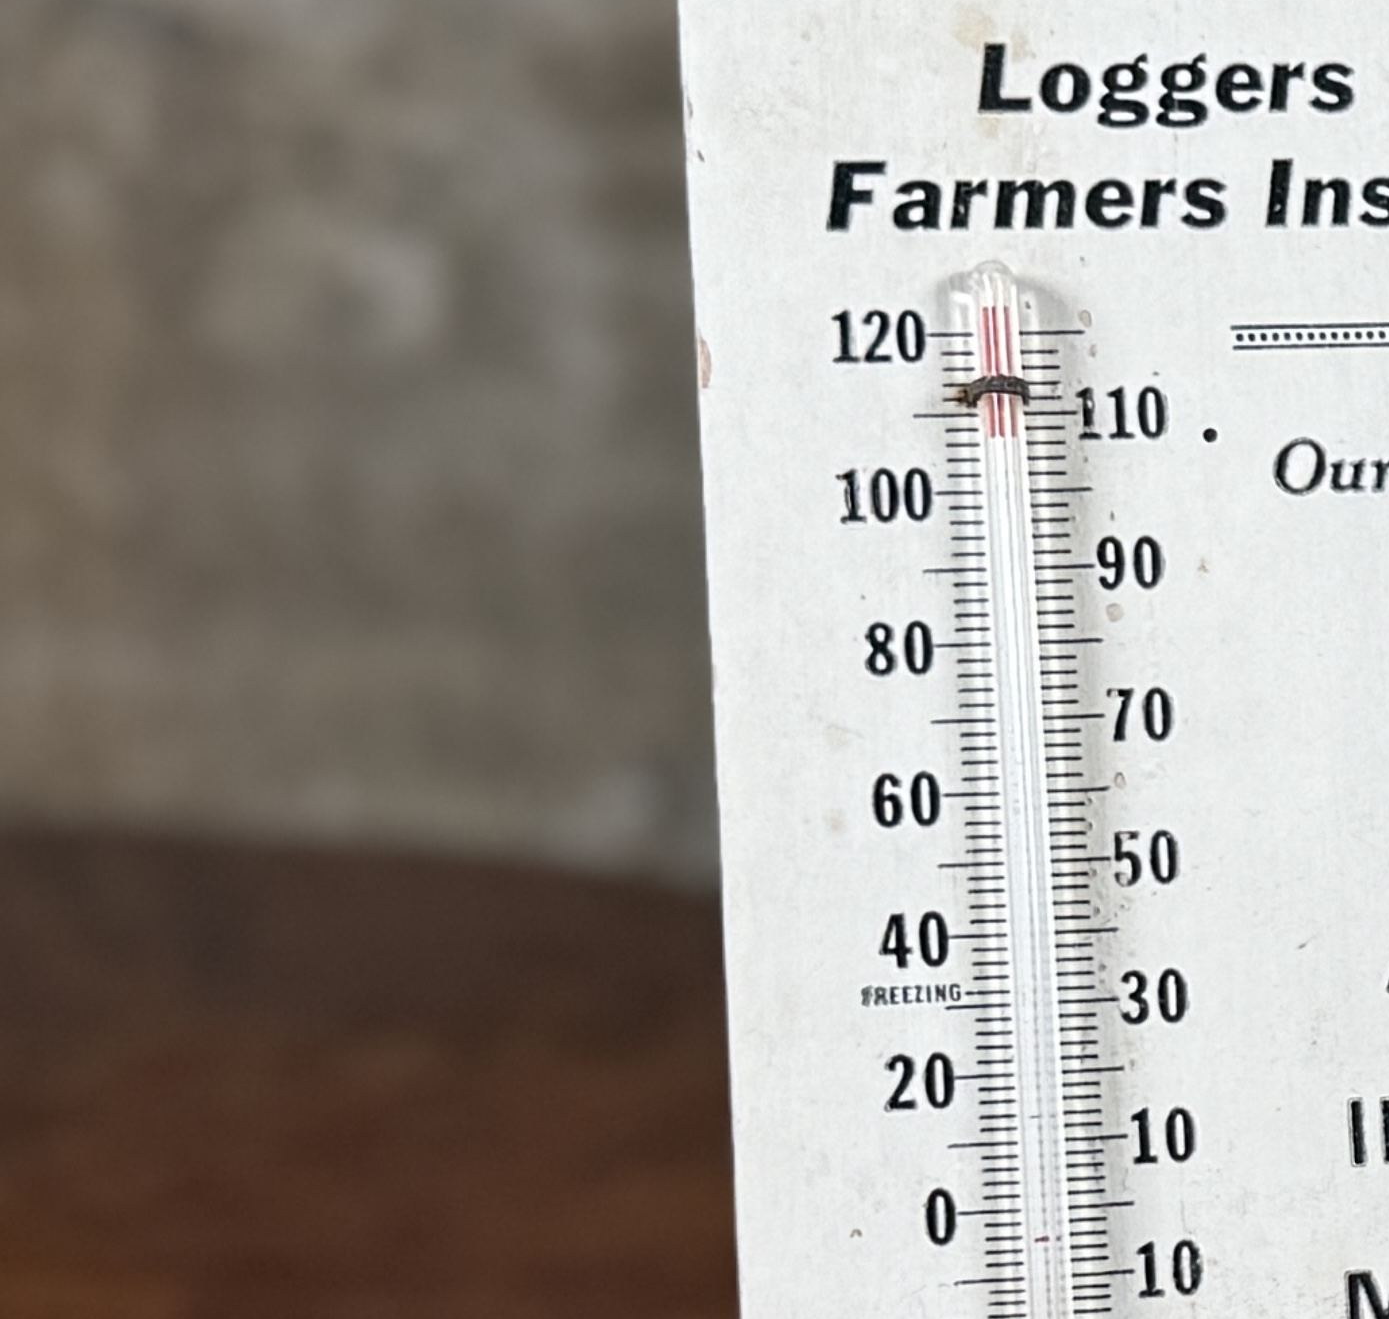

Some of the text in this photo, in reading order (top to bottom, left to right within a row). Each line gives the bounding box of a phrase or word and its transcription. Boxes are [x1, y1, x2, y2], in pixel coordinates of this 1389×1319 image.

[977, 42, 1355, 129] Loggers
[825, 160, 1227, 232] Farmers
[830, 308, 927, 365] 120
[1077, 385, 1168, 440] 110
[834, 466, 933, 525] 100
[1096, 535, 1164, 590] 90
[863, 620, 935, 677] 80
[1106, 686, 1175, 743] 70
[871, 770, 942, 828] 60
[1112, 829, 1180, 887] 50
[878, 910, 950, 969] 40
[860, 983, 962, 1007] FREEZING
[1119, 967, 1190, 1025] 30
[883, 1050, 957, 1111] 20
[1129, 1106, 1196, 1166] 10
[924, 1187, 958, 1247] 0
[1135, 1238, 1204, 1300] 10
